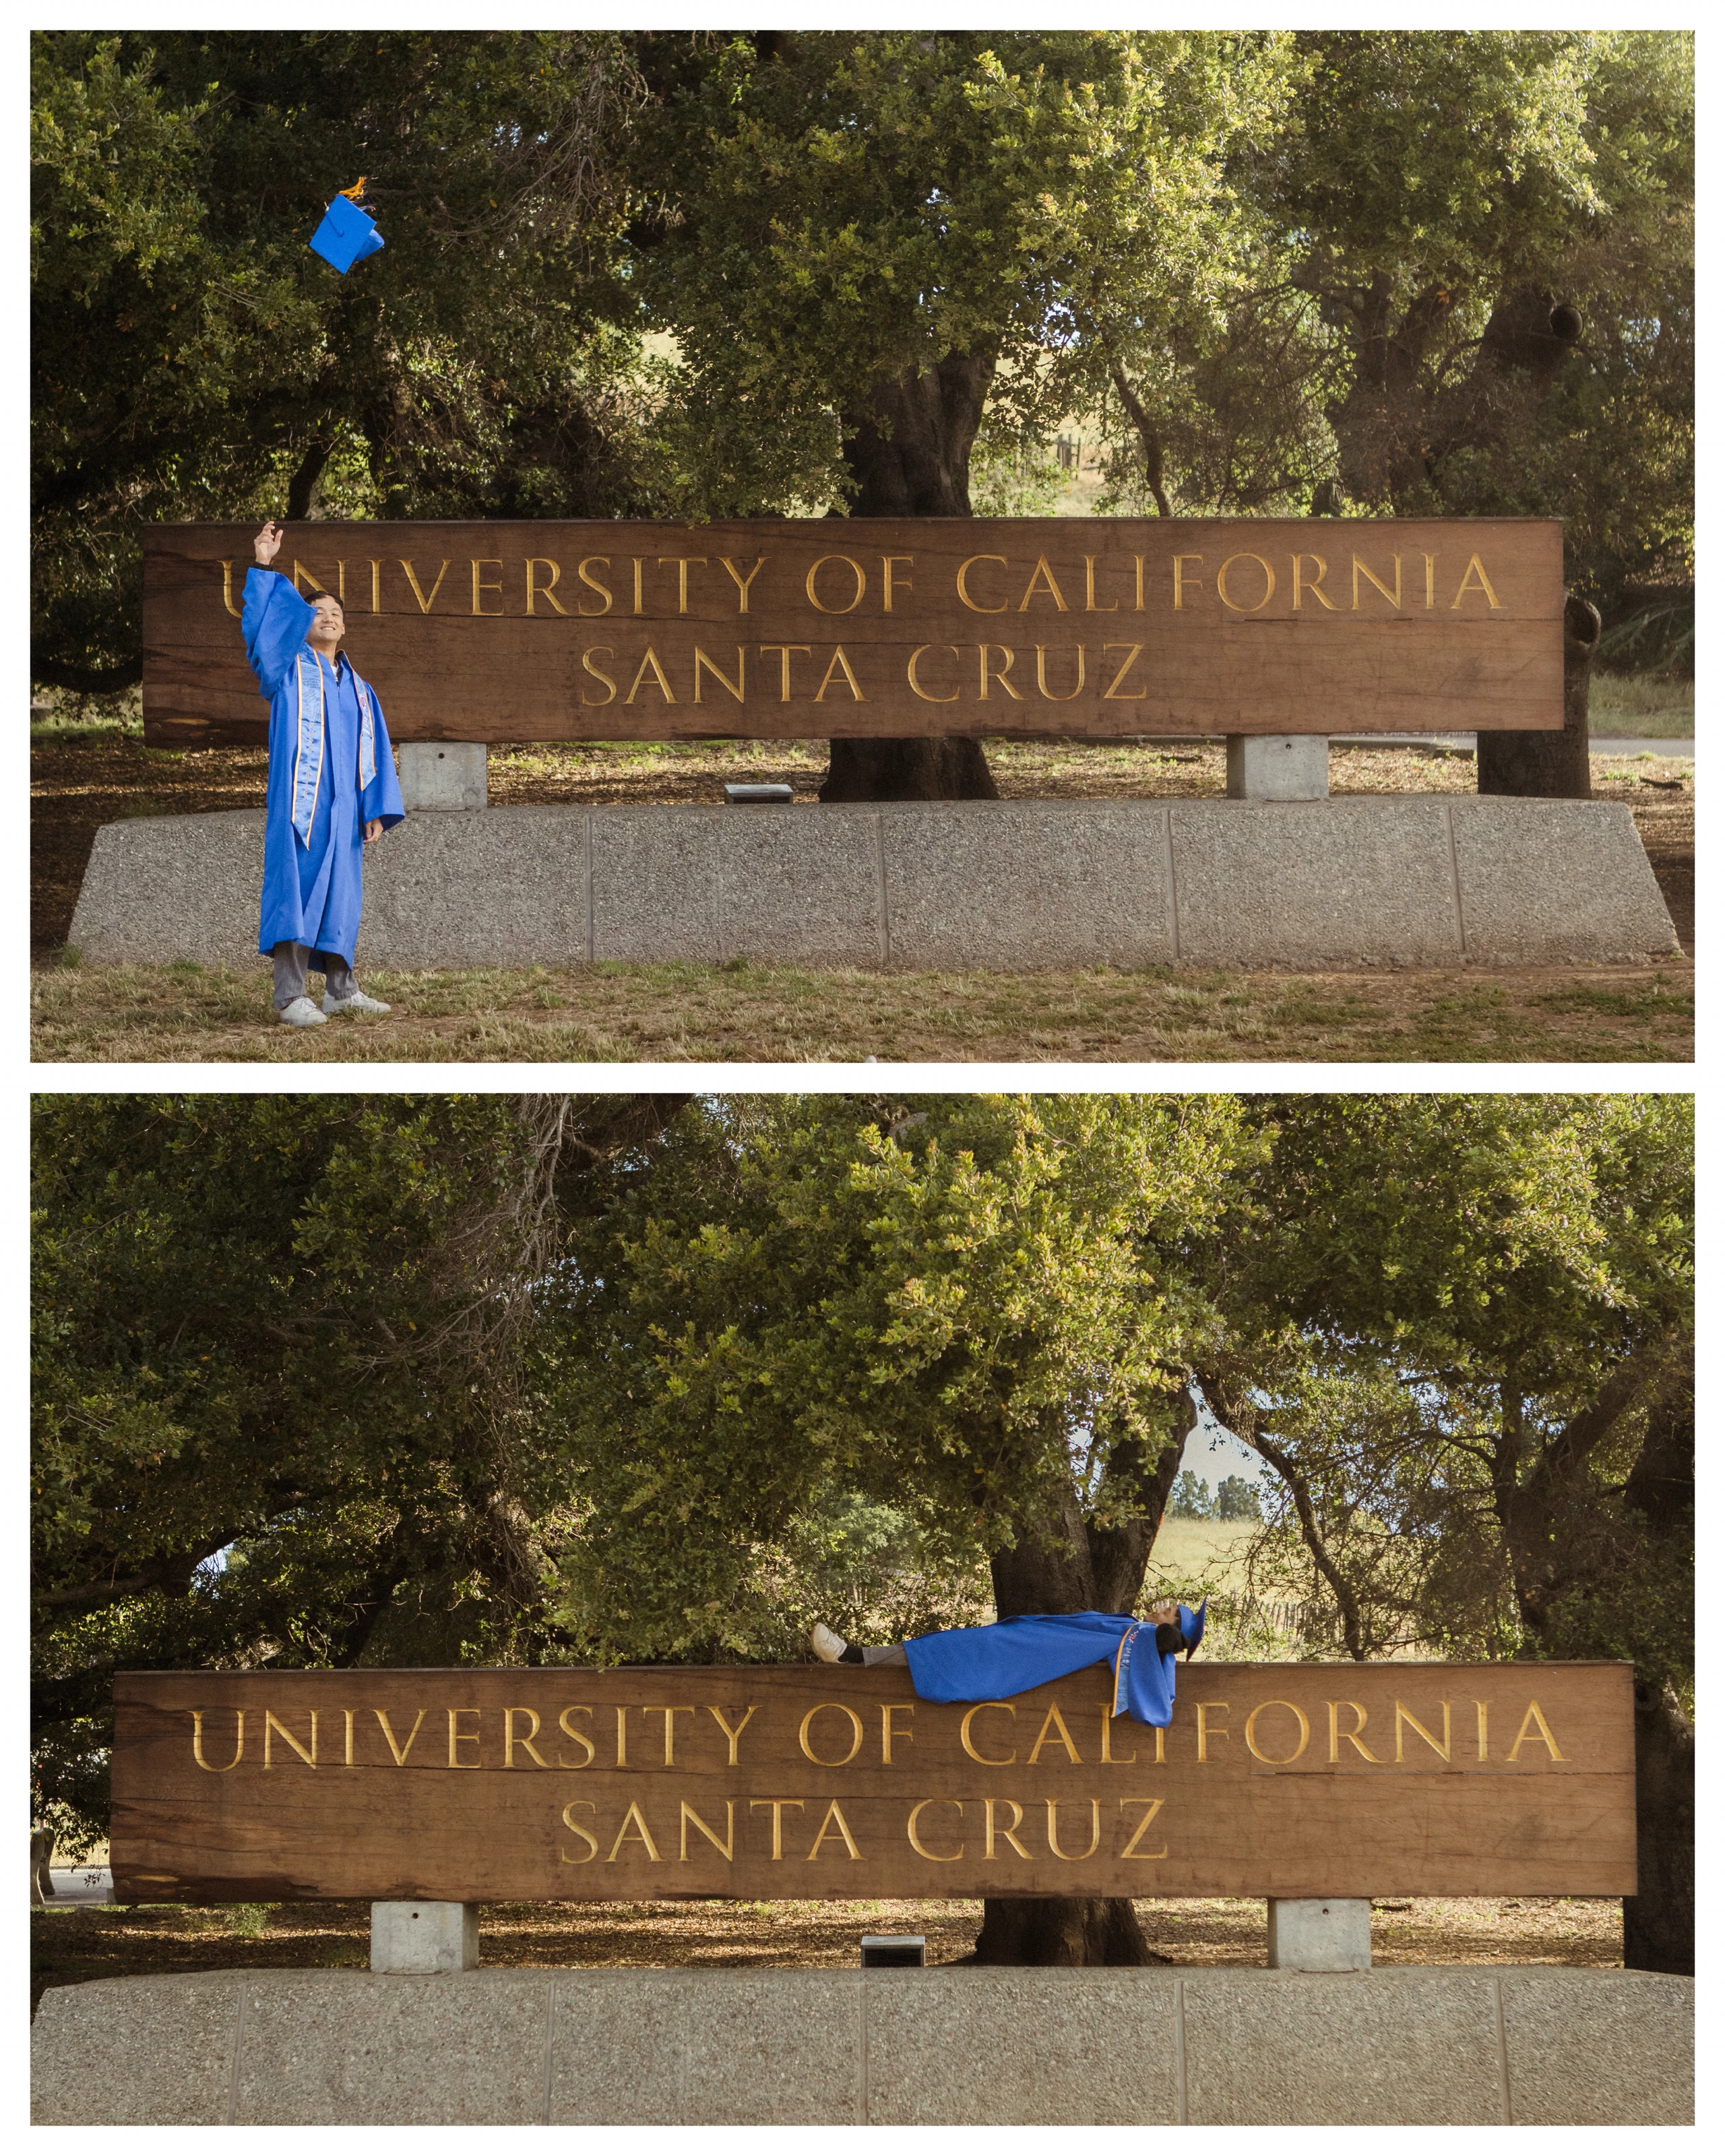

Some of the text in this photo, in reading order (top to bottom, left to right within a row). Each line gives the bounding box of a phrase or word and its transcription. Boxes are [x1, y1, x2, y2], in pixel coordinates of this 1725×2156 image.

[806, 554, 914, 614] OF
[956, 552, 1509, 612] CALIFORNIA
[582, 643, 1148, 707] SANTA CRUZ
[187, 1705, 763, 1772] UNIVERSITY
[798, 1702, 915, 1766] OF
[561, 1797, 1168, 1864] SANTA CRUZ
